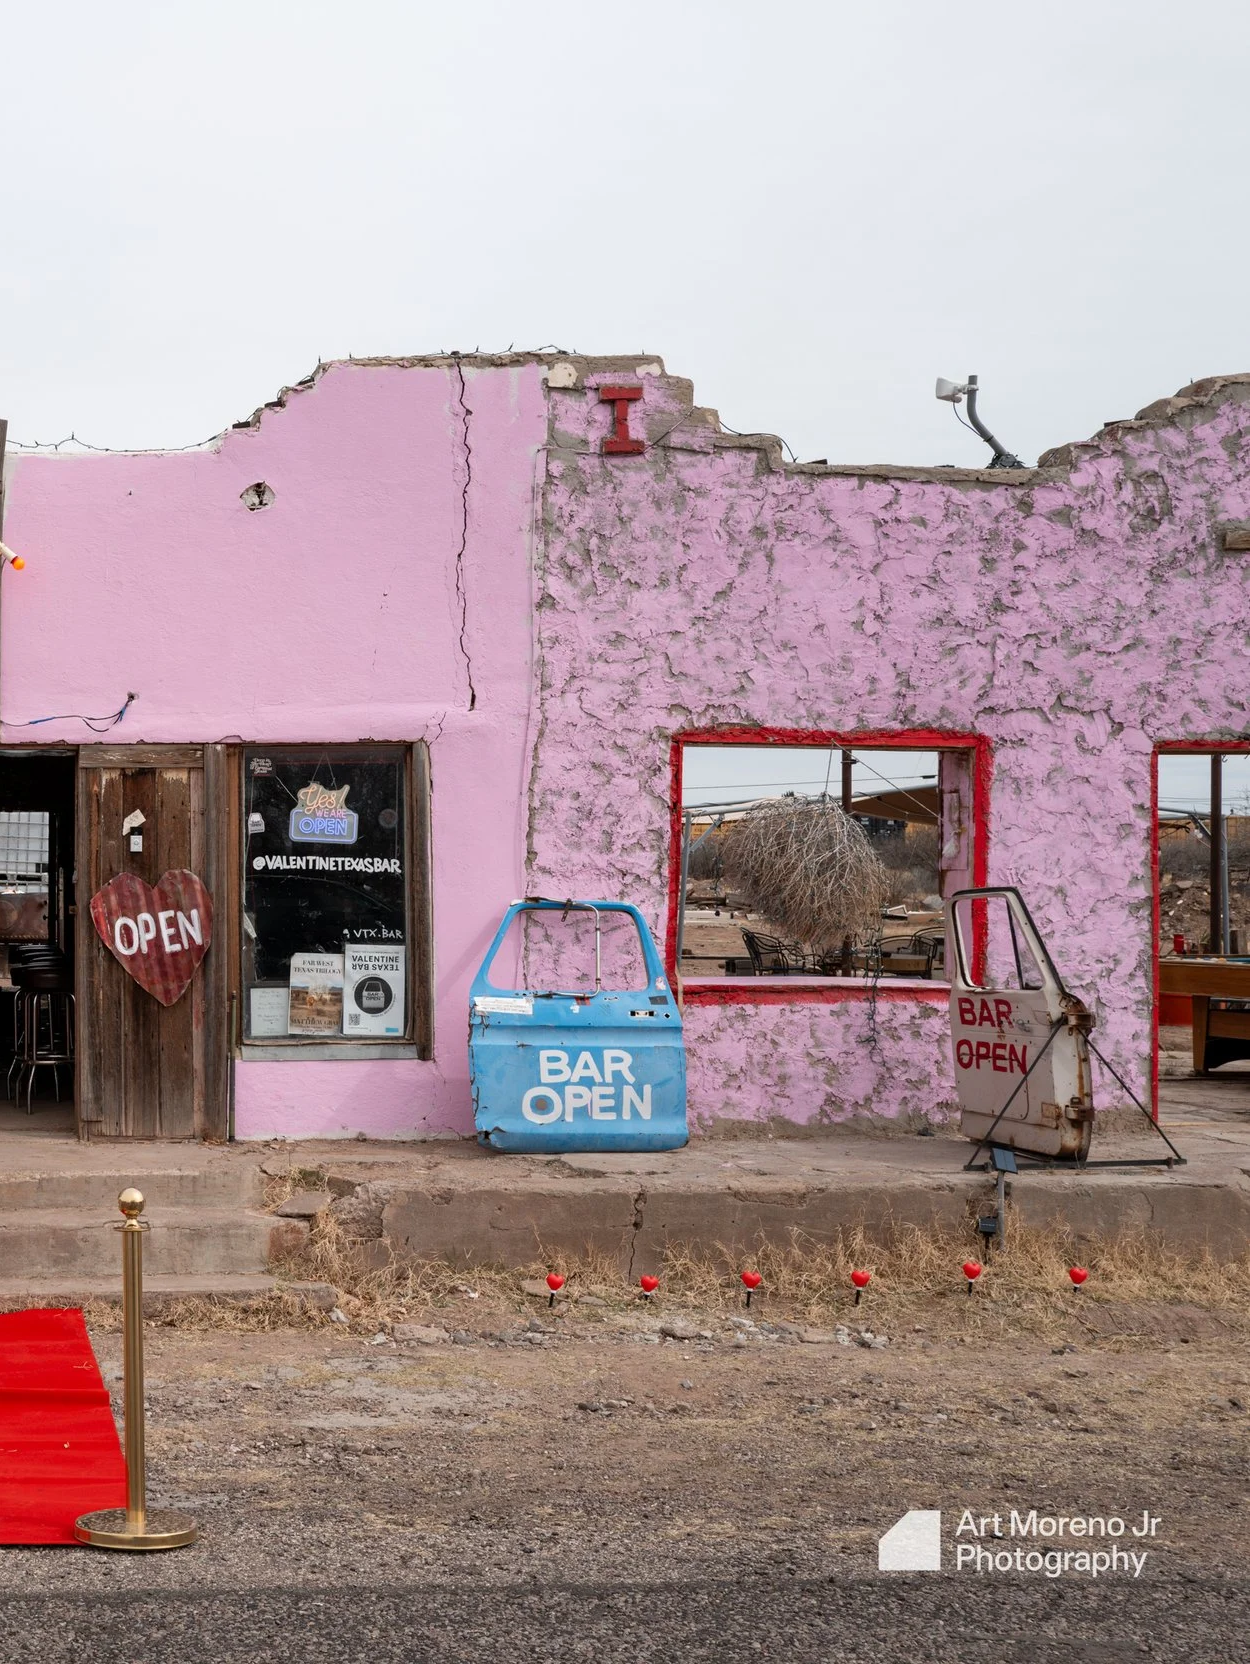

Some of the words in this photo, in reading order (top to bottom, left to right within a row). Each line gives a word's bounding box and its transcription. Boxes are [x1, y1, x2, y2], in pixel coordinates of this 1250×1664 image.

[299, 784, 350, 814] Yes!
[315, 808, 330, 818] WE
[330, 808, 347, 819] ARE
[299, 817, 348, 836] OPEN
[252, 855, 402, 874] @VALENTINETEXASBAR
[113, 908, 203, 956] OPEN
[353, 927, 404, 939] VTX.BAR
[351, 955, 400, 963] VALENTINE
[351, 963, 370, 971] BAR
[372, 963, 400, 971] TEXAS
[957, 998, 1015, 1029] BAR
[539, 1049, 636, 1084] BAR
[956, 1039, 1027, 1075] OPEN
[522, 1084, 652, 1124] OPEN
